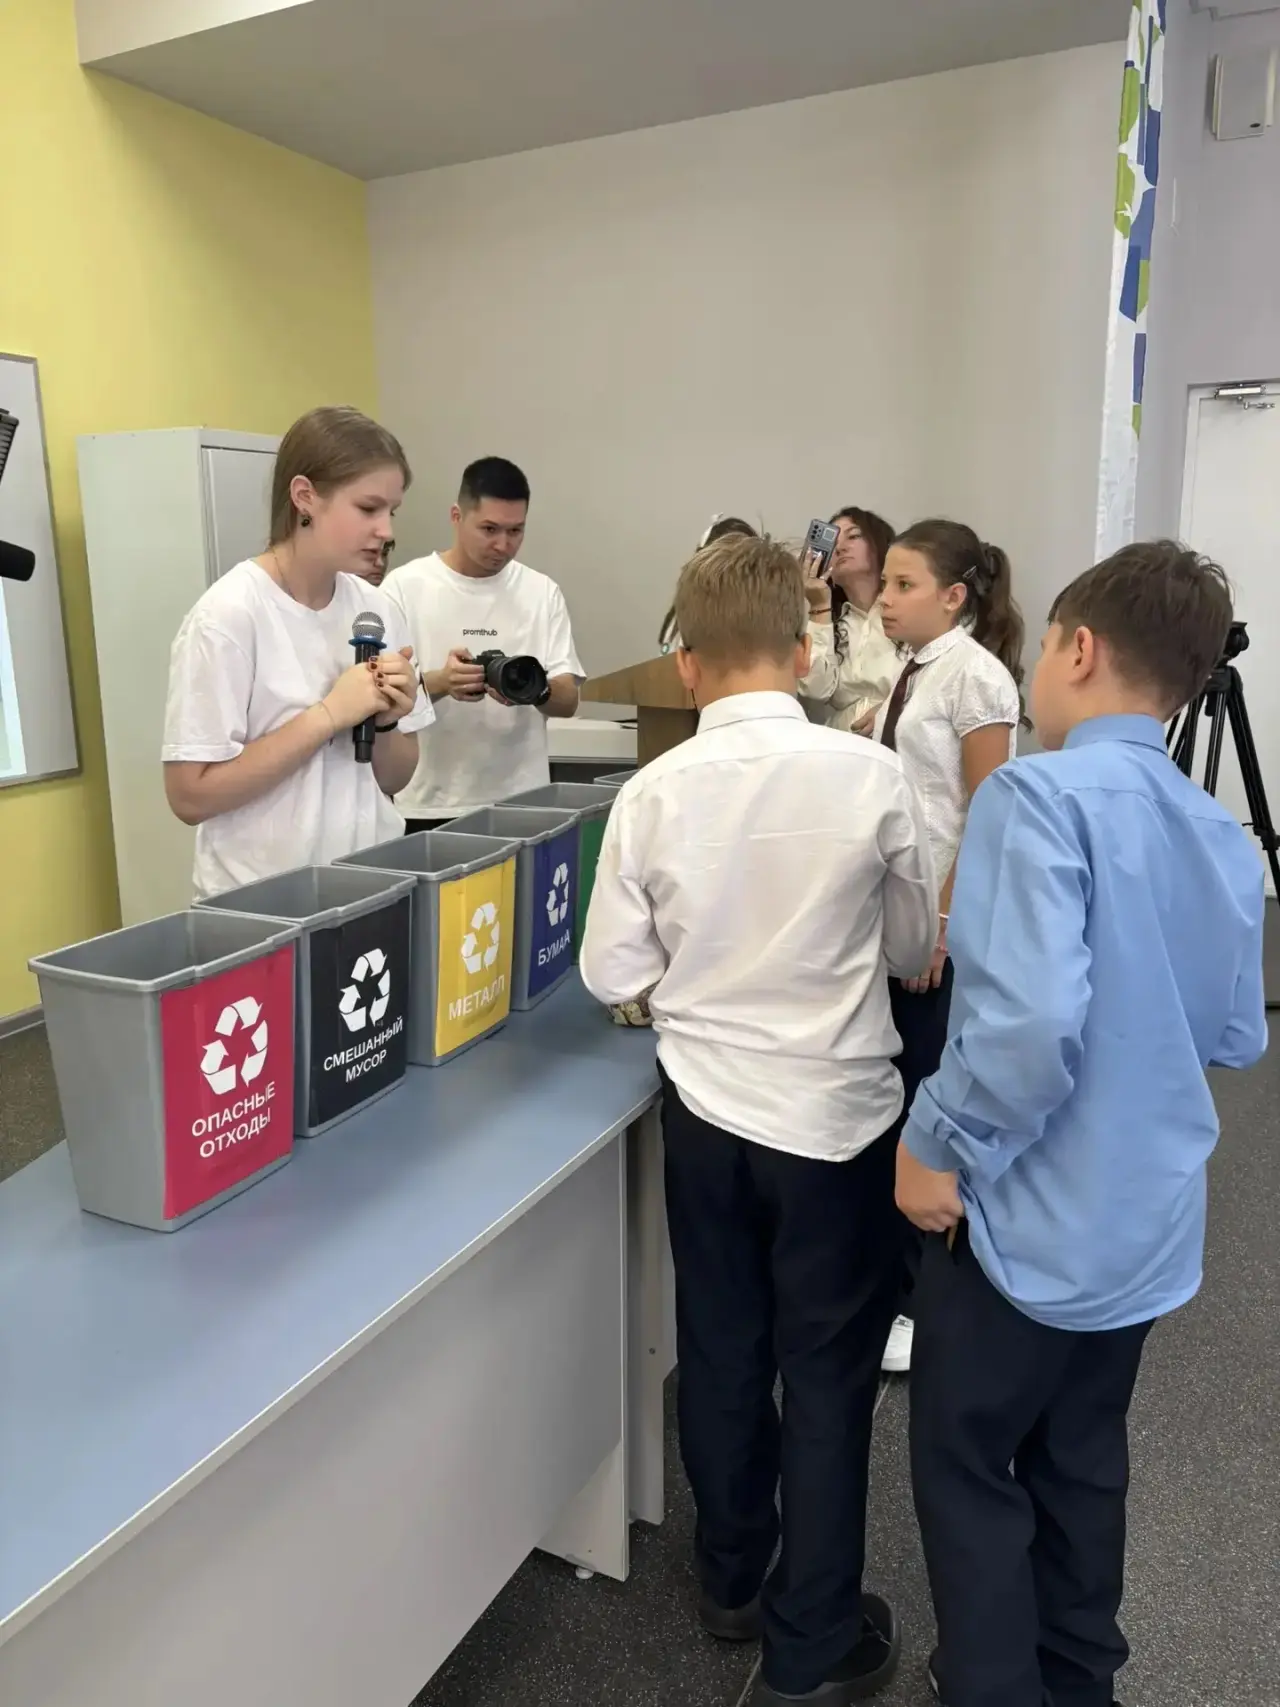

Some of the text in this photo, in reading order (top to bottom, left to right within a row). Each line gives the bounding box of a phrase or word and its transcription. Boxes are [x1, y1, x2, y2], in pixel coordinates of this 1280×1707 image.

[462, 628, 498, 637] promthub
[448, 974, 505, 1021] МЕТАЛЛ
[323, 1015, 403, 1071] СМЕШАННЫЙ
[345, 1049, 387, 1083] МУСОР
[191, 1080, 276, 1137] ОПАСНЫЕ
[199, 1107, 271, 1158] ОТХОДЫ
